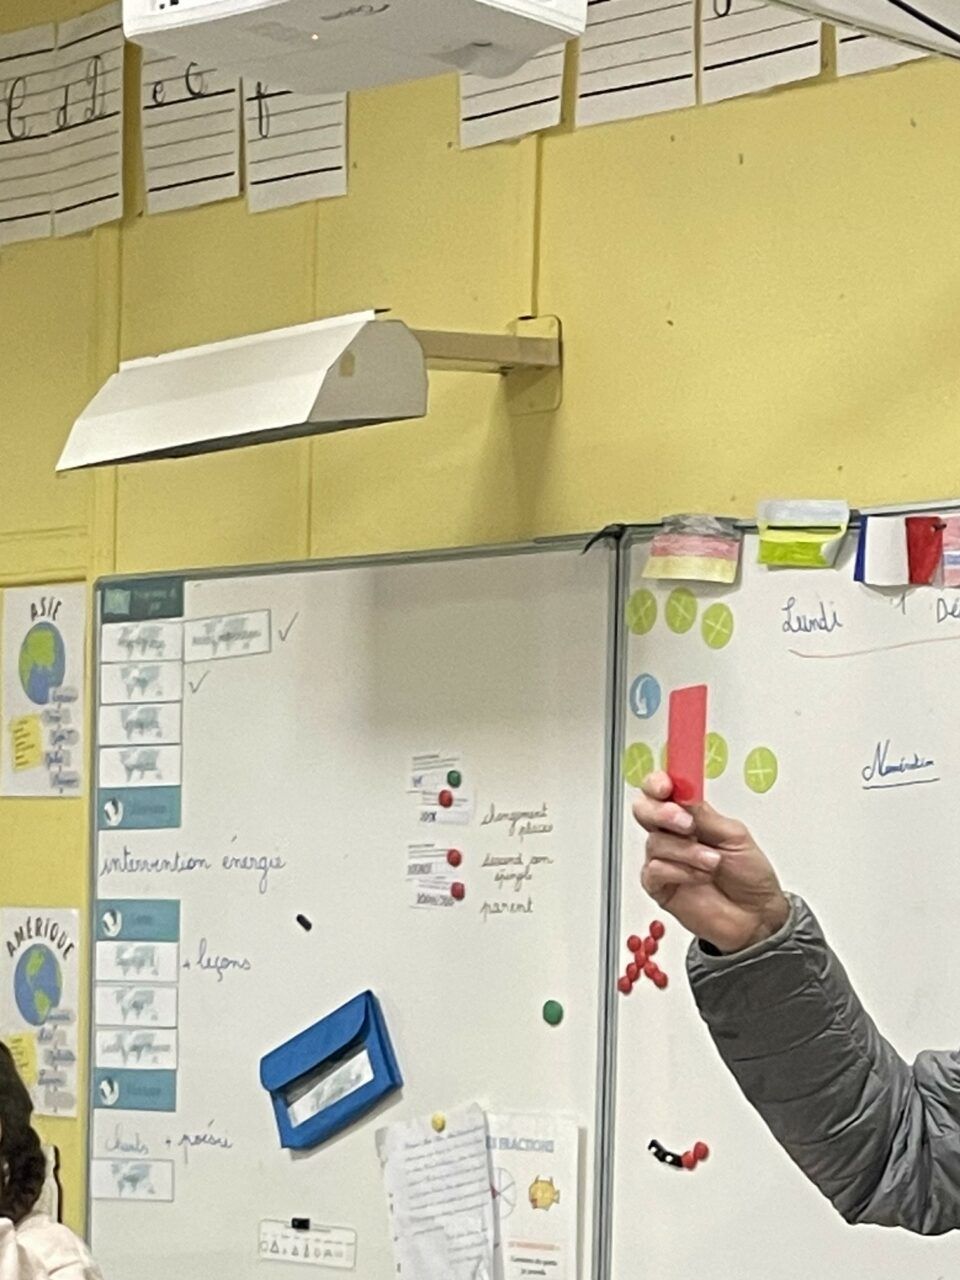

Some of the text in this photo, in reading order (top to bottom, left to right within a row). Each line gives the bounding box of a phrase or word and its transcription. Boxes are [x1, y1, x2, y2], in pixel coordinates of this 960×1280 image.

[30, 596, 63, 622] ASIE
[782, 596, 843, 633] Lundi
[100, 845, 213, 877] intervention
[196, 937, 252, 983] leçons
